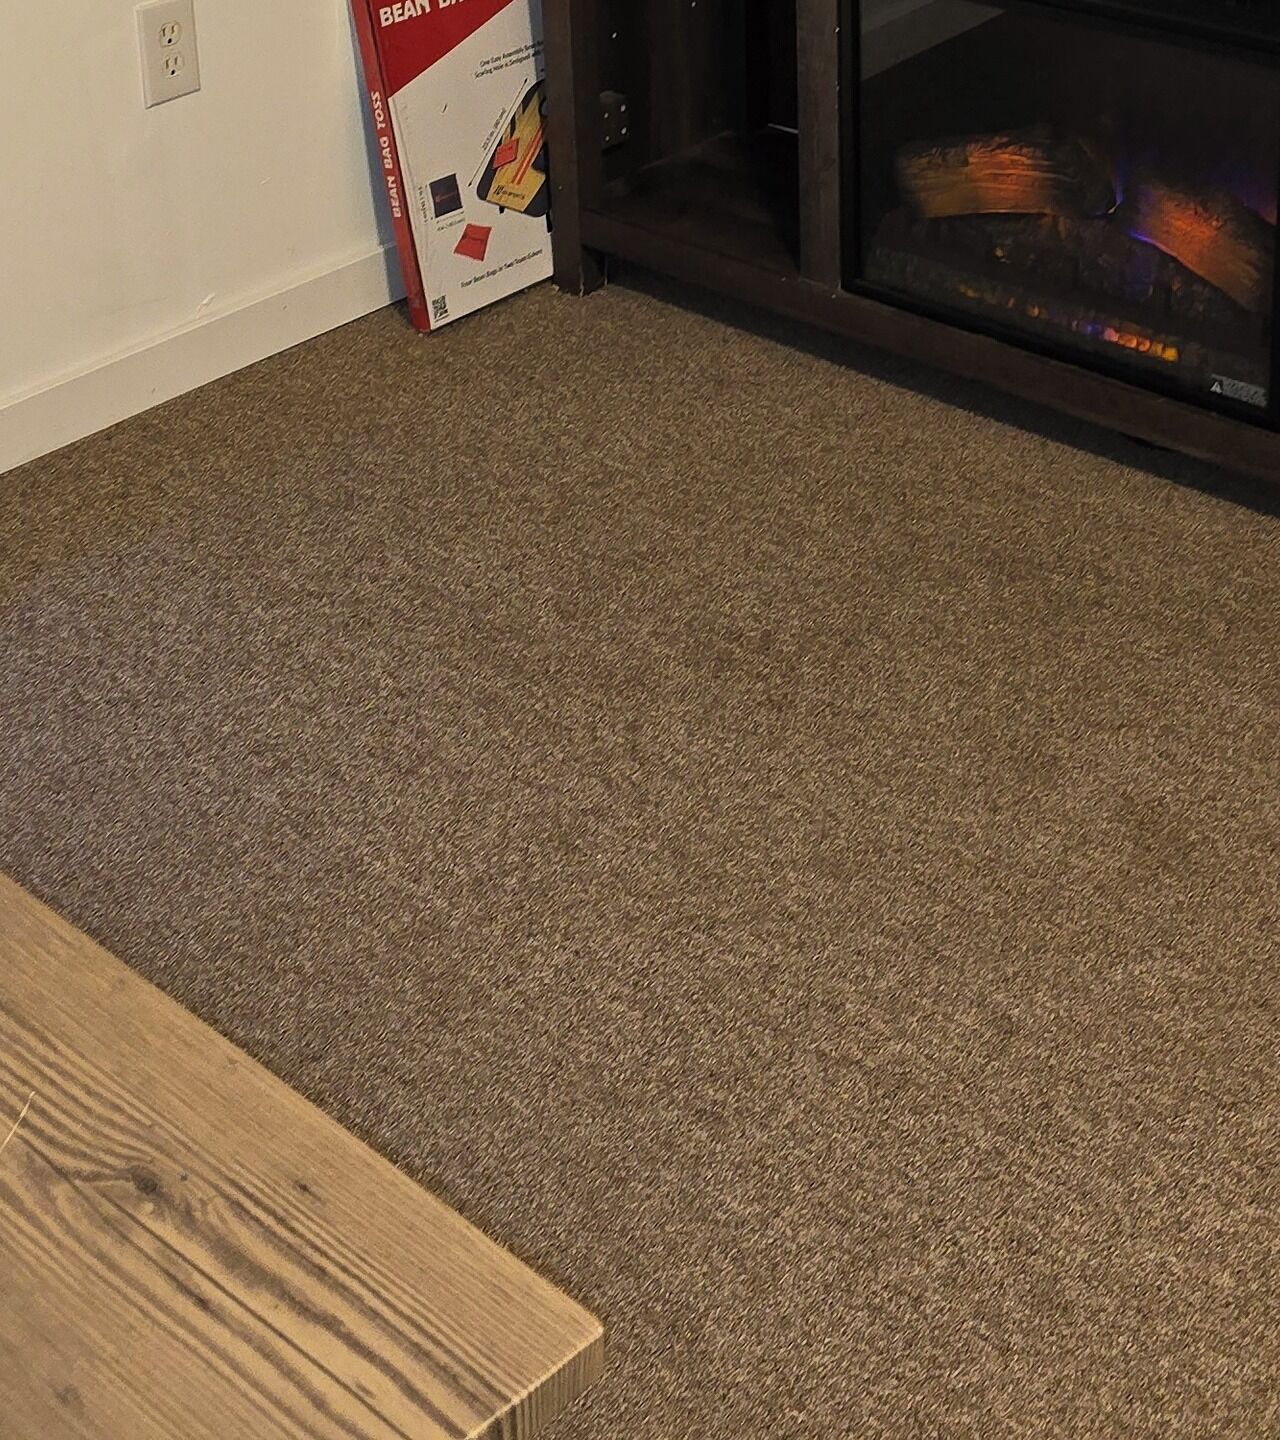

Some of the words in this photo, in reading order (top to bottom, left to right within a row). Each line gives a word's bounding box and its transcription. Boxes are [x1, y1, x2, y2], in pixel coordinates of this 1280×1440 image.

[371, 91, 386, 130] TOSS
[380, 136, 392, 169] BAG
[387, 176, 401, 217] BEAN
